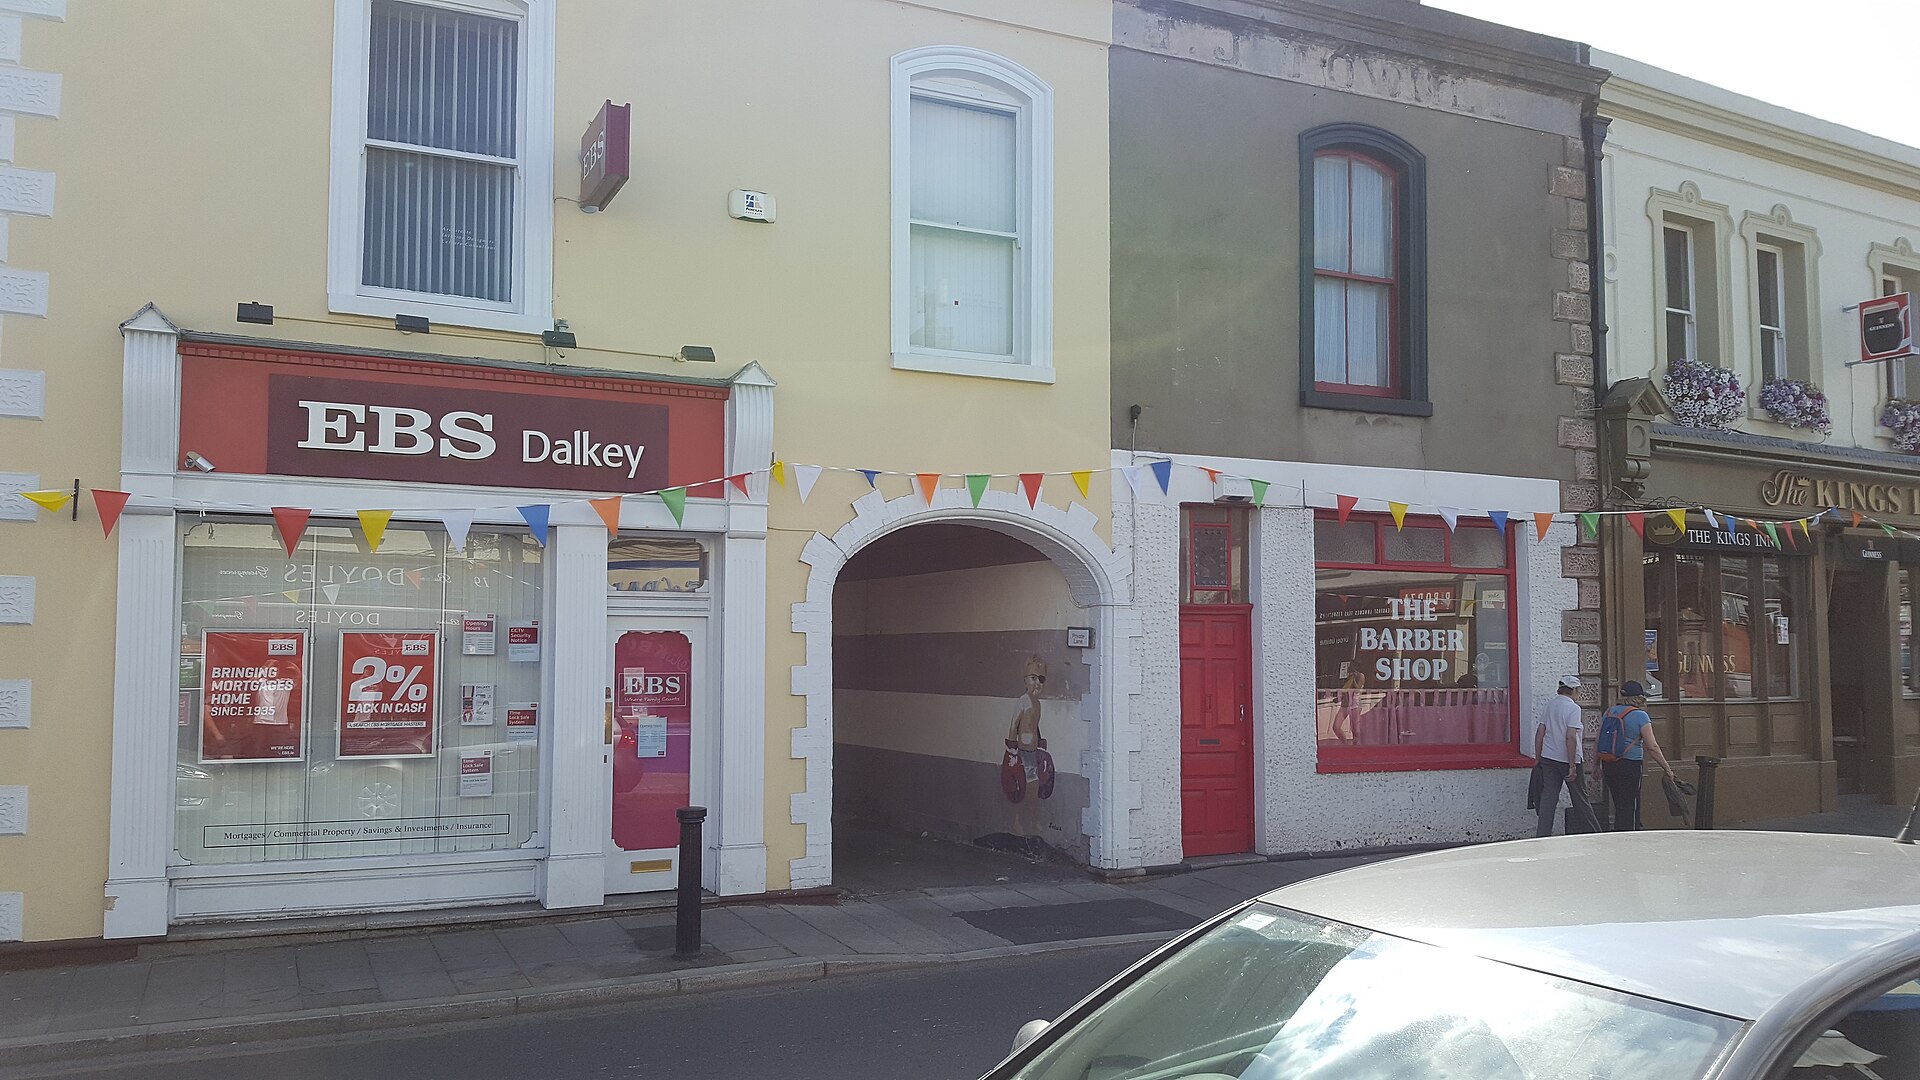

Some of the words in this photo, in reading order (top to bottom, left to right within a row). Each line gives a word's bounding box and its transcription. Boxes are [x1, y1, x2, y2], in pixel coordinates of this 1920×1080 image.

[582, 130, 605, 181] EBS
[1869, 323, 1895, 331] GUINNESS
[297, 399, 498, 461] EBS
[520, 429, 646, 479] Dalkey
[1761, 469, 1809, 507] The
[1815, 478, 1904, 514] KINGS
[1687, 529, 1712, 544] THE
[1716, 531, 1751, 547] KINGS
[1755, 533, 1776, 548] INN
[1387, 598, 1438, 622] THE
[270, 642, 294, 651] EBS
[404, 642, 427, 651] EBS
[1360, 627, 1465, 652] BARBER
[211, 667, 278, 678] BRINGING
[348, 656, 428, 702] 2%
[1375, 657, 1449, 682] SHOP
[210, 678, 294, 691] MORTGAGES
[624, 676, 682, 695] EBS
[210, 693, 251, 705] HOME
[346, 702, 380, 714] BACK
[380, 702, 393, 713] IN
[394, 702, 427, 713] CASH
[210, 706, 244, 717] SINCE
[246, 706, 276, 716] 1935
[223, 831, 266, 841] Mortgages
[273, 829, 321, 838] Commercial
[322, 827, 356, 838] Property
[363, 826, 393, 836] Savings
[394, 825, 402, 833] &
[403, 823, 449, 833] Investments
[456, 821, 493, 831] Insurance
